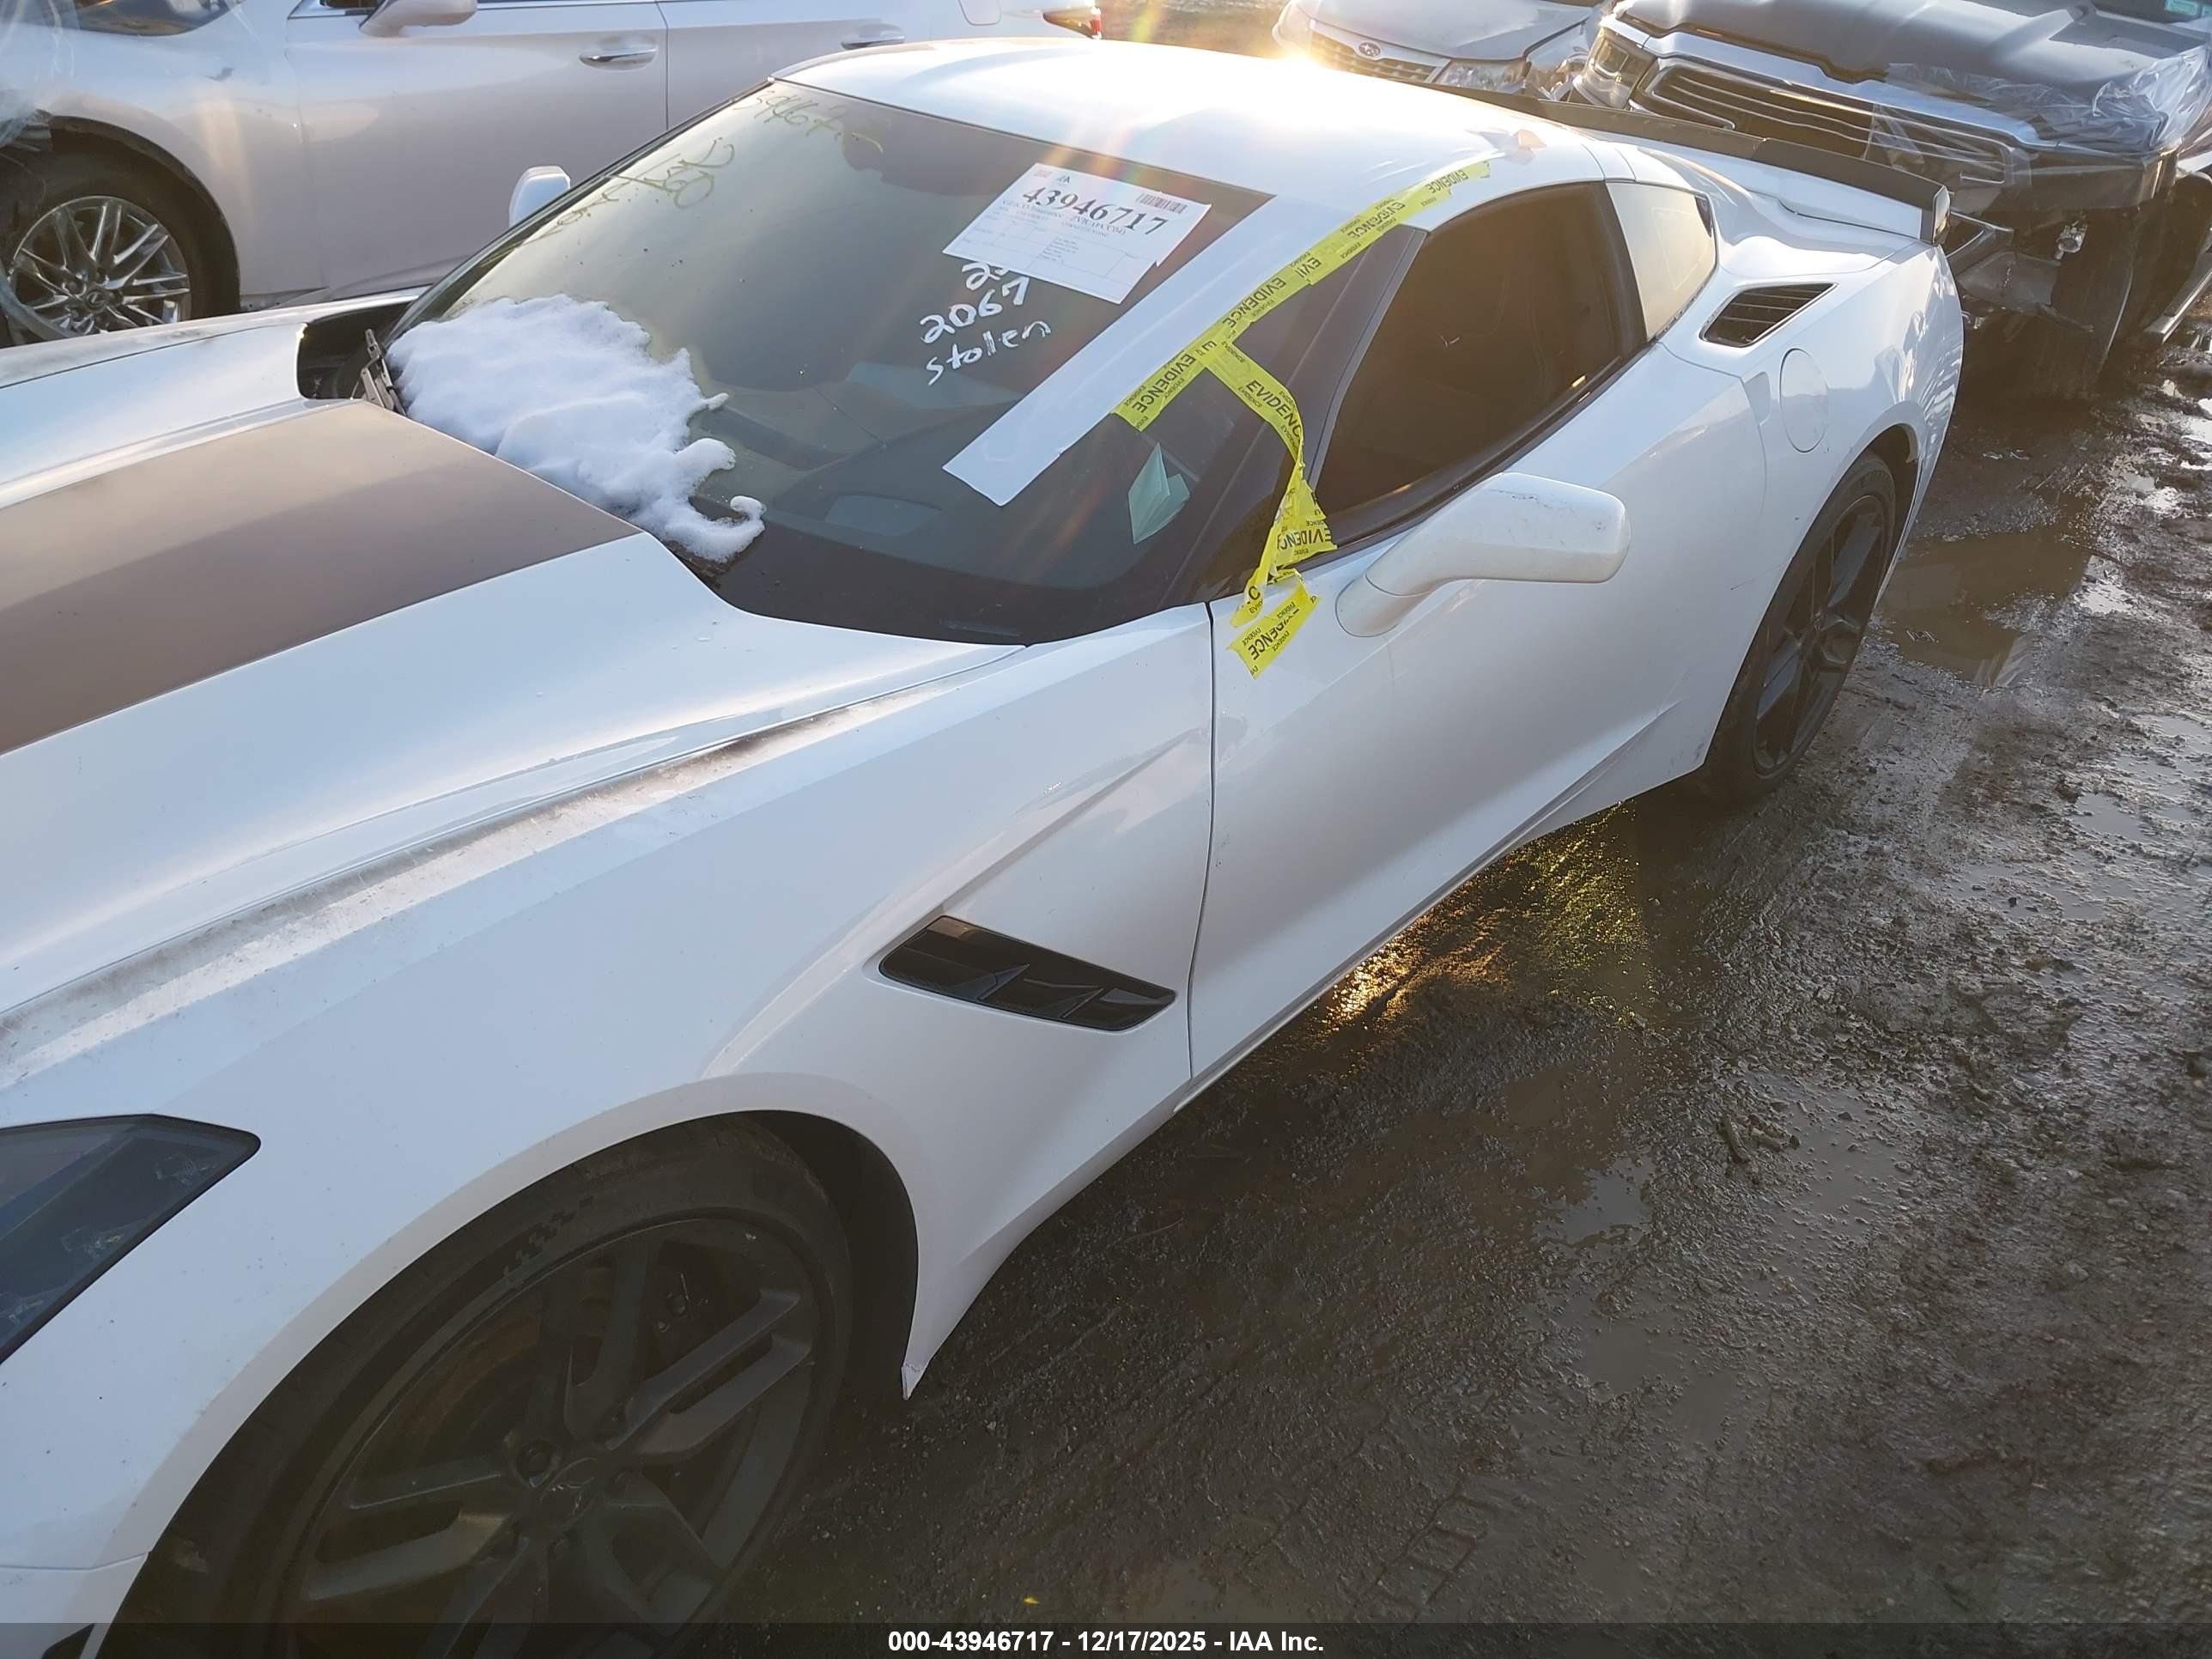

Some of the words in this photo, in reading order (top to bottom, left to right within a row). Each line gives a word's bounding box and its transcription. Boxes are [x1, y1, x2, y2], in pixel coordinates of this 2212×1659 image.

[1426, 169, 1468, 194] EVIDENCE
[1023, 186, 1169, 235] 43946717
[1222, 277, 1286, 329] EVIDENCE
[926, 320, 1052, 386] stolen
[1131, 353, 1196, 414] EVIDENCE
[1245, 380, 1304, 448] EVIDENC
